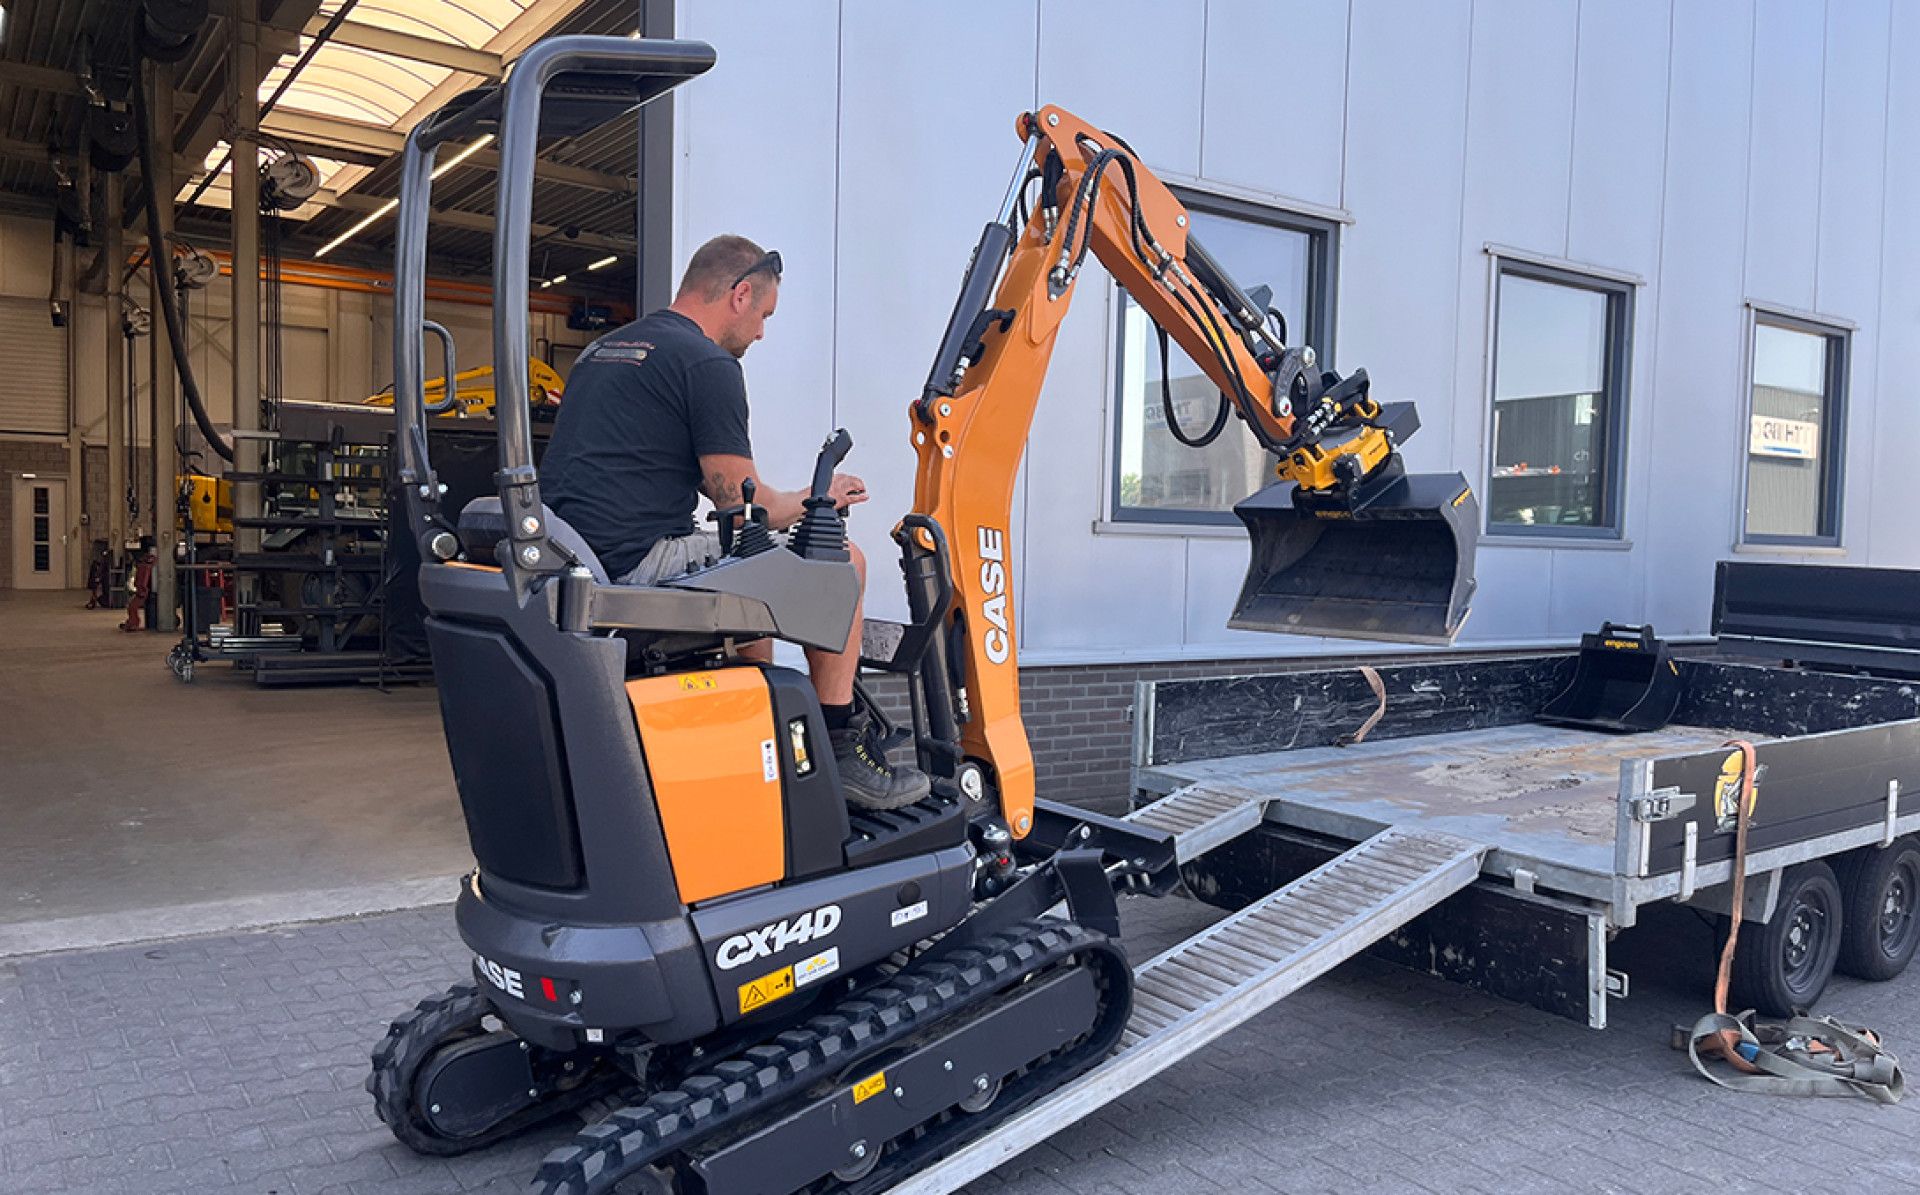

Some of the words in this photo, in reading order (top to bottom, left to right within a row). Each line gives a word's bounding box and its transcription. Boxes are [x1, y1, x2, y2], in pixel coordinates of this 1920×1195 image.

[978, 526, 1009, 664] CASE
[716, 905, 842, 970] CX14D
[477, 955, 525, 999] ASE
